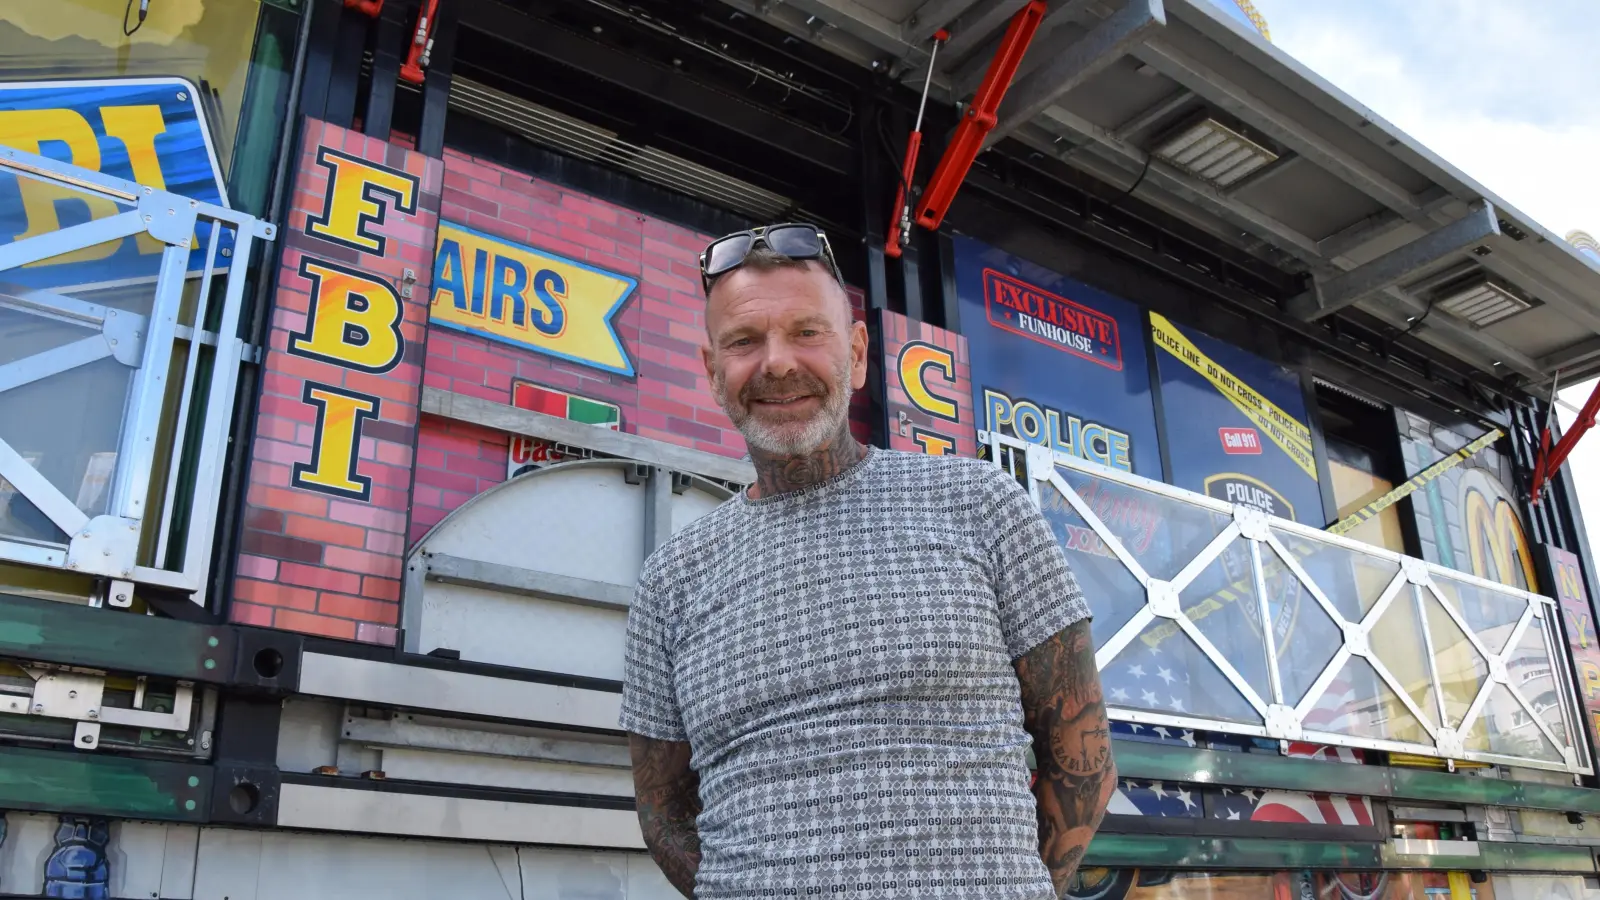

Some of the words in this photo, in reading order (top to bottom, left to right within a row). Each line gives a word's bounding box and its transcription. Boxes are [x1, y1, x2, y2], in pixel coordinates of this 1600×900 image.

[287, 145, 420, 502] FBI
[992, 278, 1113, 345] EXCLUSIVE
[1018, 312, 1094, 354] FUNHOUSE
[1151, 324, 1181, 353] POLICE
[1182, 346, 1201, 367] LINE
[1207, 364, 1218, 379] DO
[1220, 374, 1236, 391] NOT
[1237, 385, 1263, 410] CROSS
[1268, 407, 1294, 432] POLICE
[983, 388, 1132, 473] POLICE
[1224, 432, 1242, 448] Call
[1242, 433, 1257, 448] 911
[1286, 439, 1310, 468] CROSS
[1226, 482, 1275, 514] POLICE
